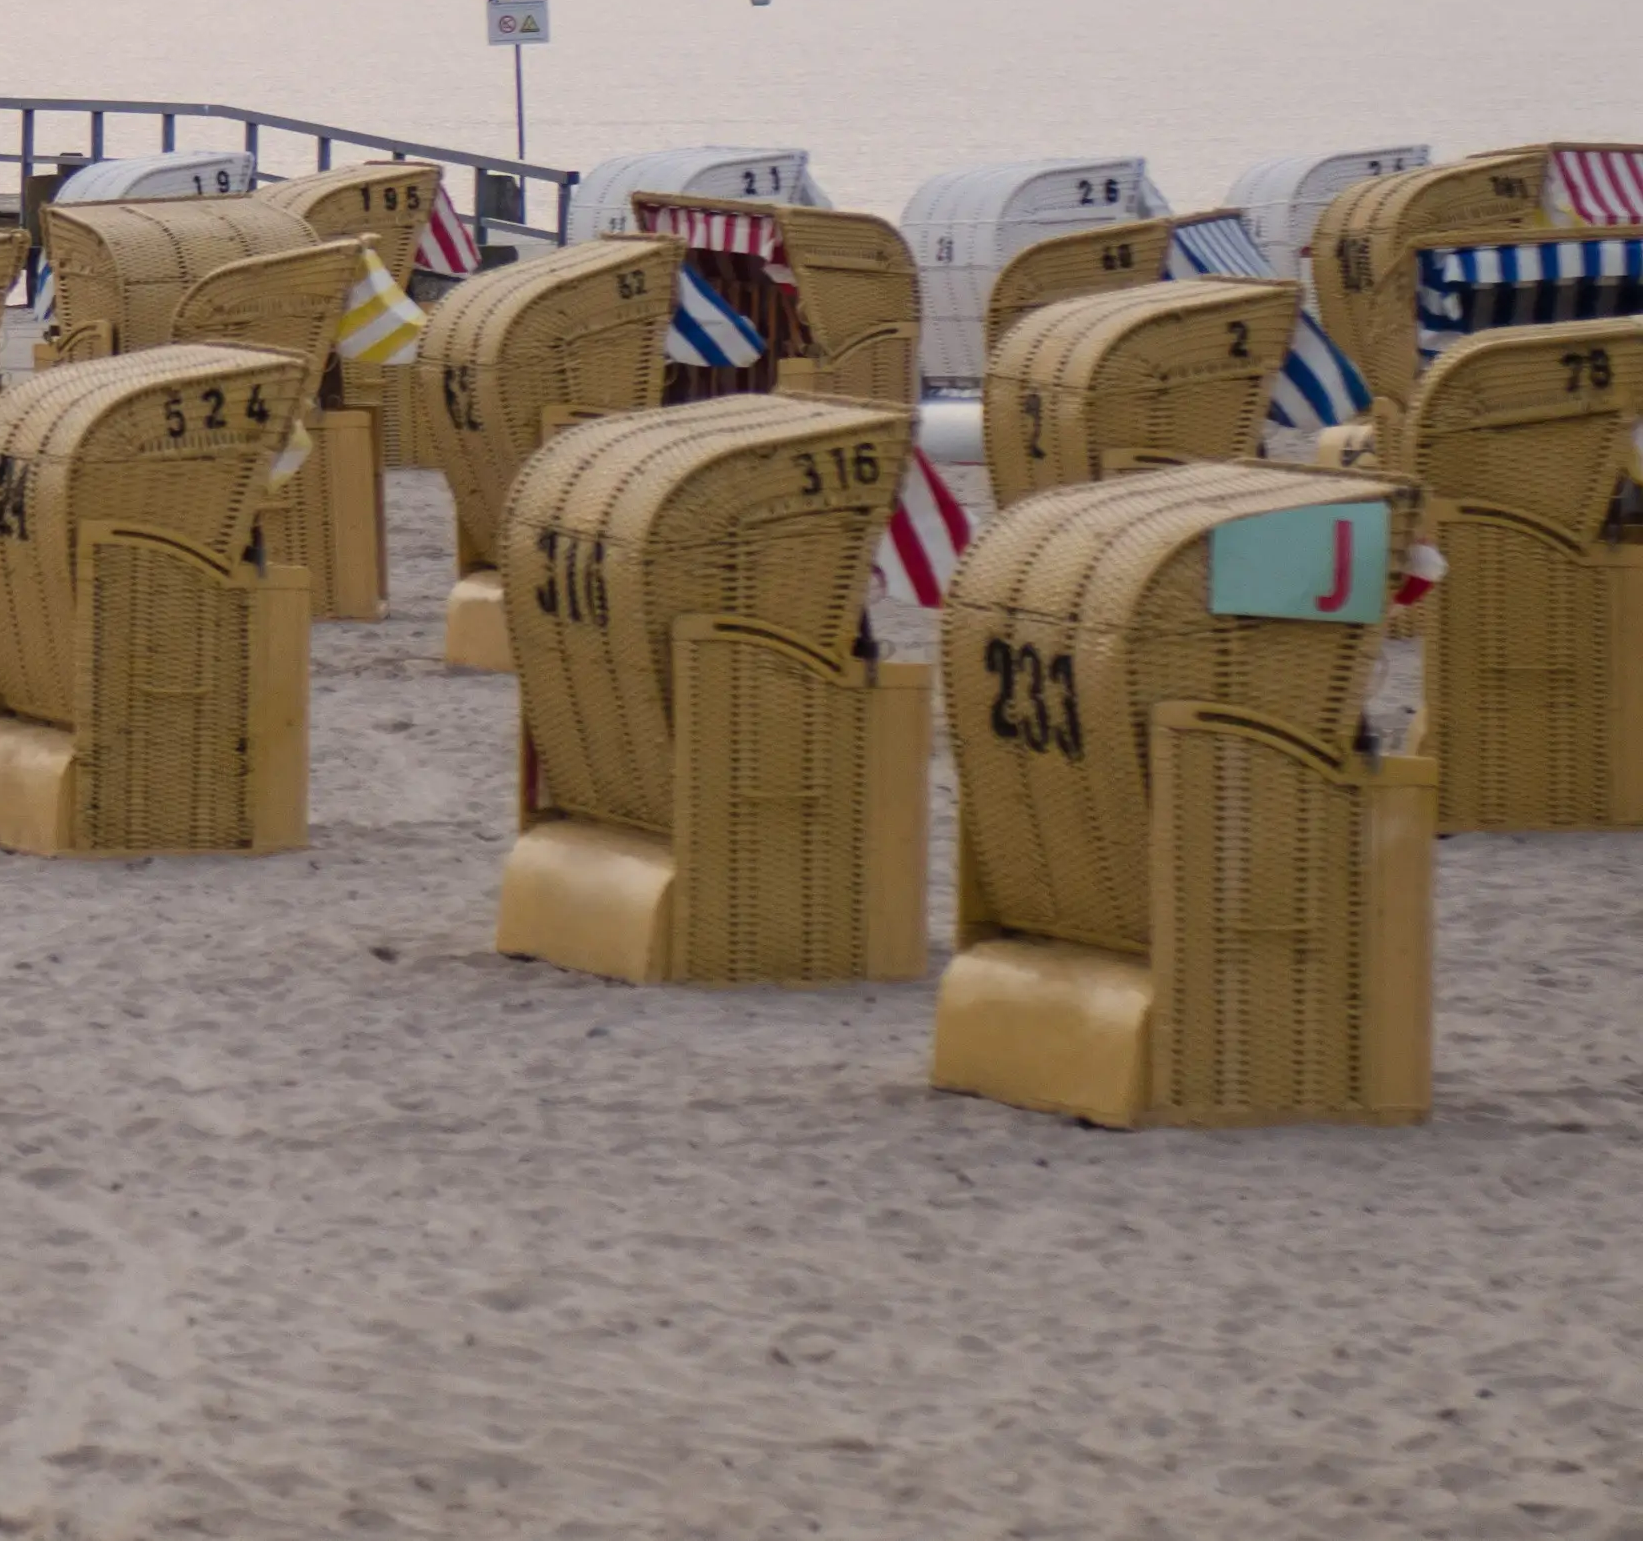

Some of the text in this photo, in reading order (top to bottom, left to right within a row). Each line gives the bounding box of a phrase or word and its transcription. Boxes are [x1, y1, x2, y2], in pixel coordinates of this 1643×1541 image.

[193, 171, 230, 196] 19
[744, 166, 781, 195] 21
[1079, 179, 1119, 205] 26
[360, 186, 420, 212] 195
[1228, 320, 1248, 358] 2
[164, 385, 271, 438] 524
[793, 442, 881, 496] 316
[1315, 520, 1352, 613] J
